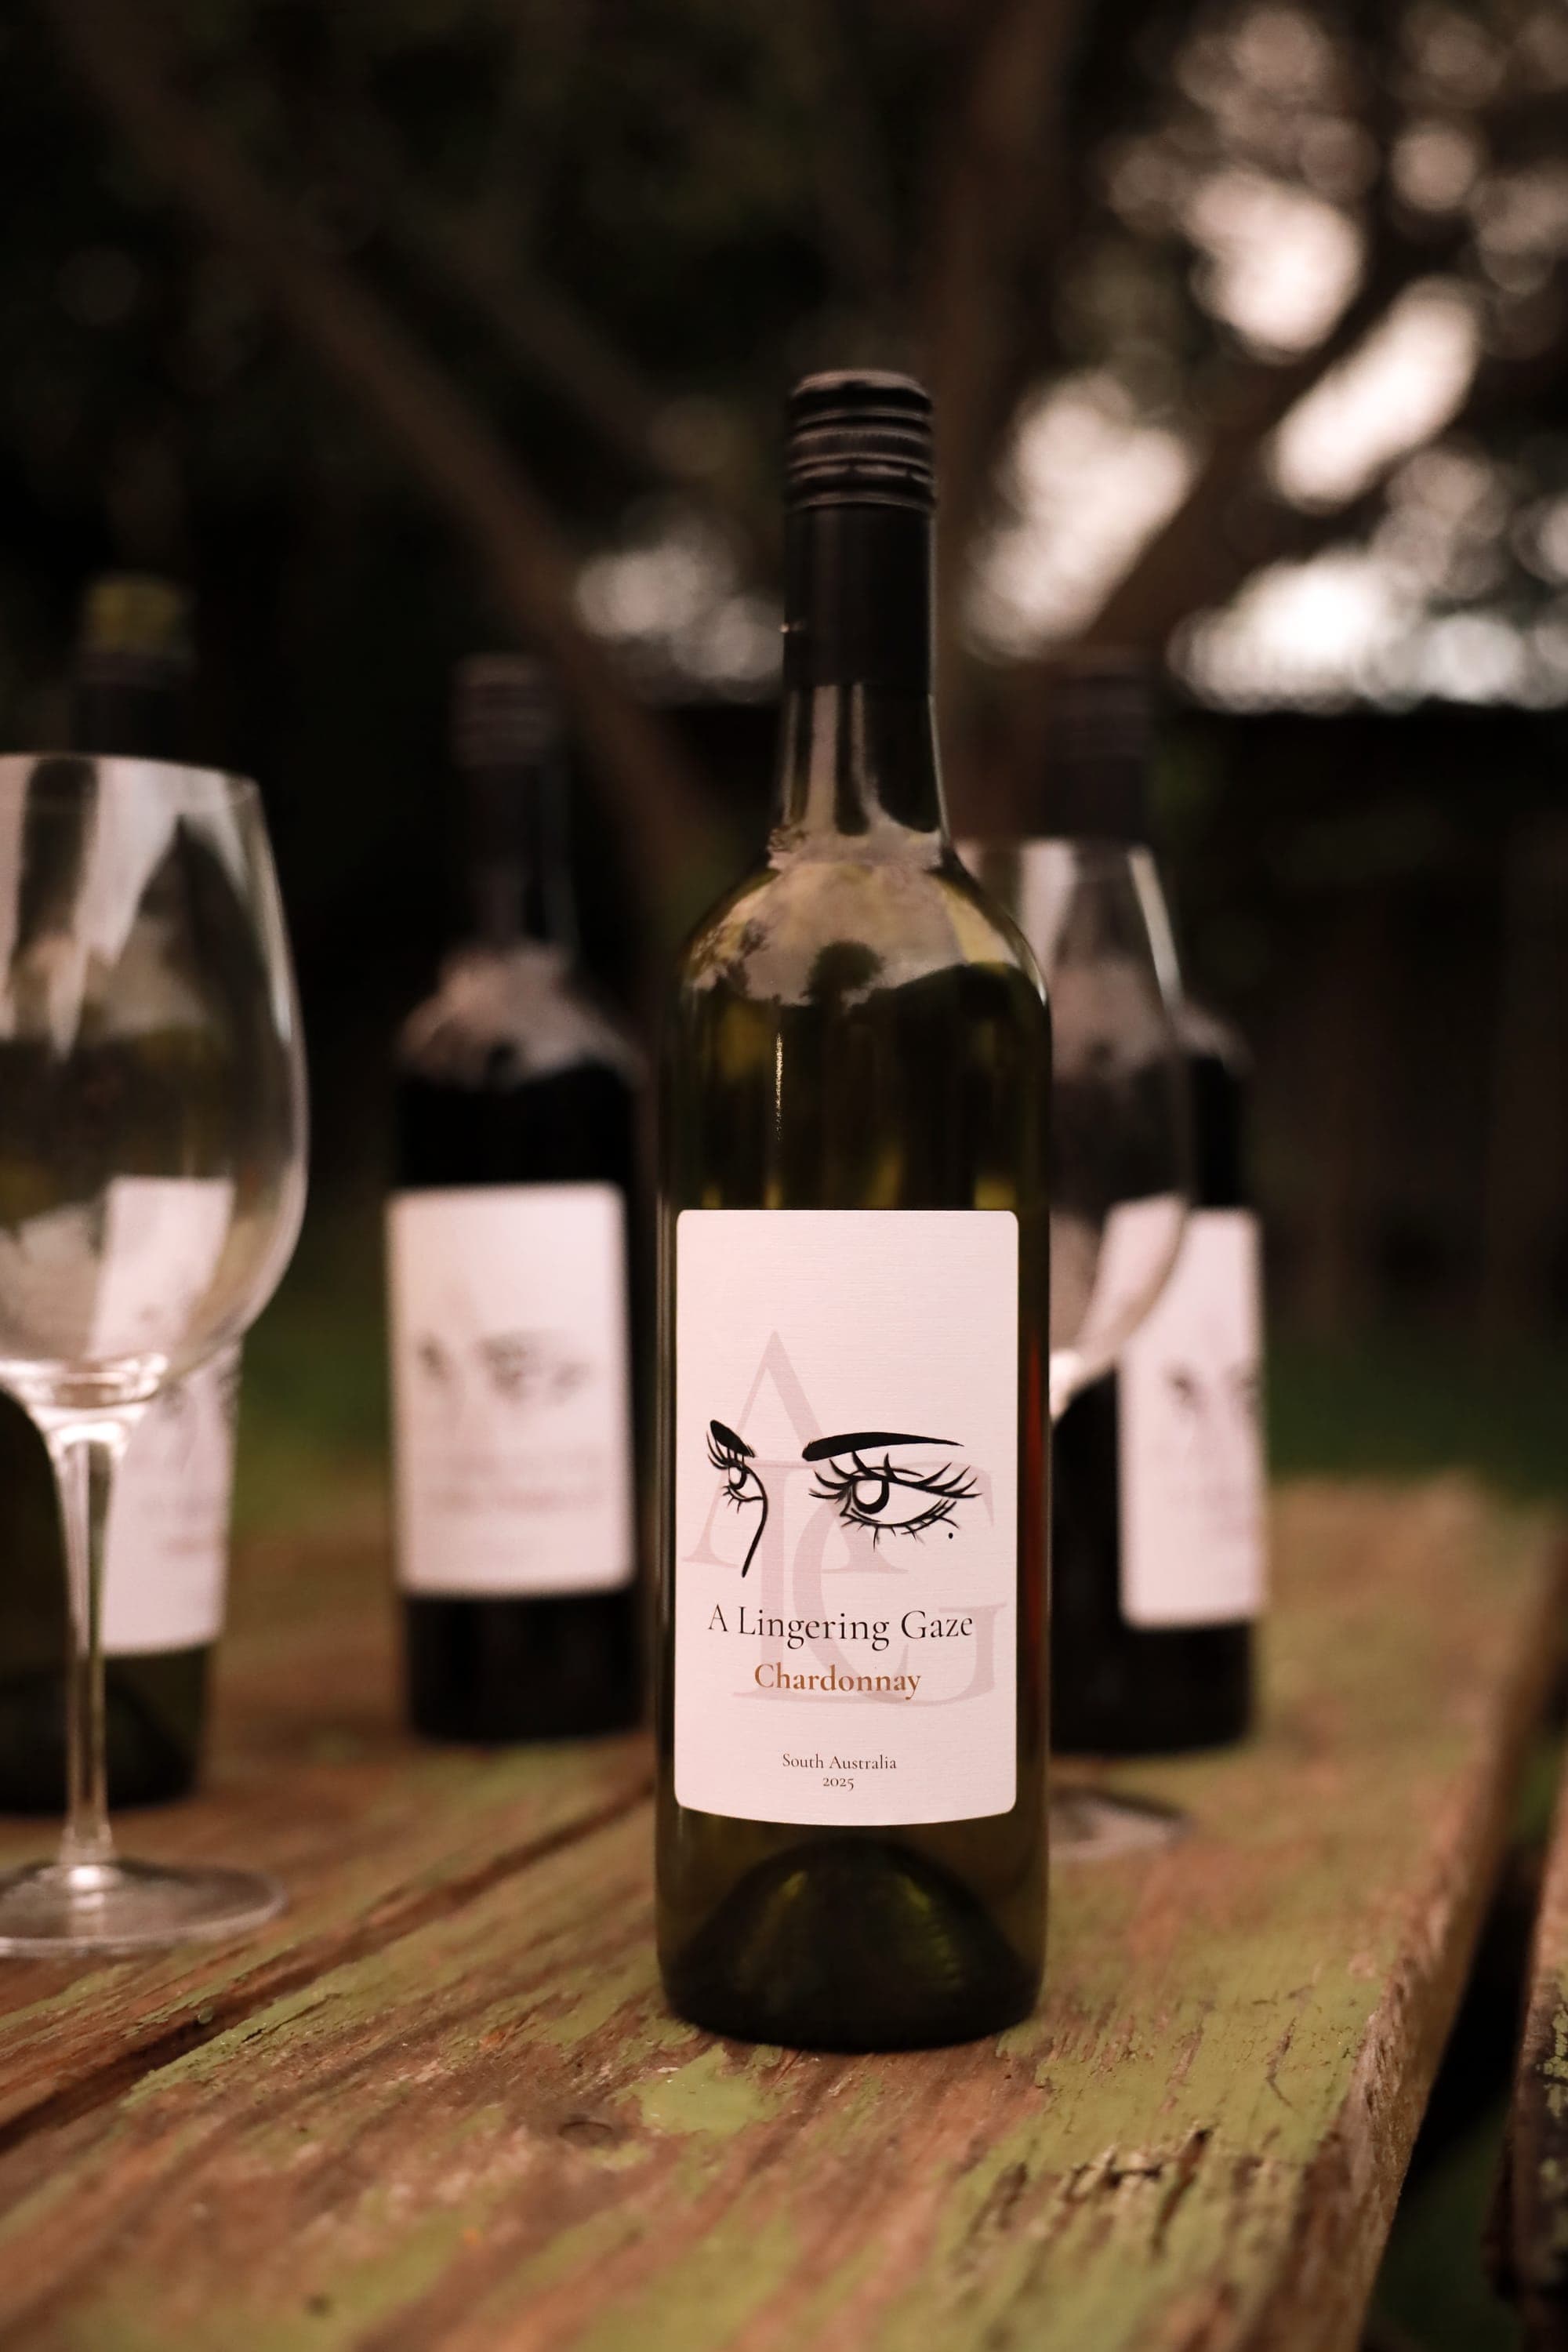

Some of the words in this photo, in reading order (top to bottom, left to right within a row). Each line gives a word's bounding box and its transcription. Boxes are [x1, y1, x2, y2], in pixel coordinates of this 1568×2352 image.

[708, 1603, 729, 1632] A
[738, 1606, 890, 1652] Lingering
[901, 1610, 973, 1639] Gaze
[754, 1661, 921, 1700] Chardonnay
[782, 1753, 824, 1769] South
[829, 1754, 897, 1769] Australia
[822, 1777, 855, 1791] 2025
